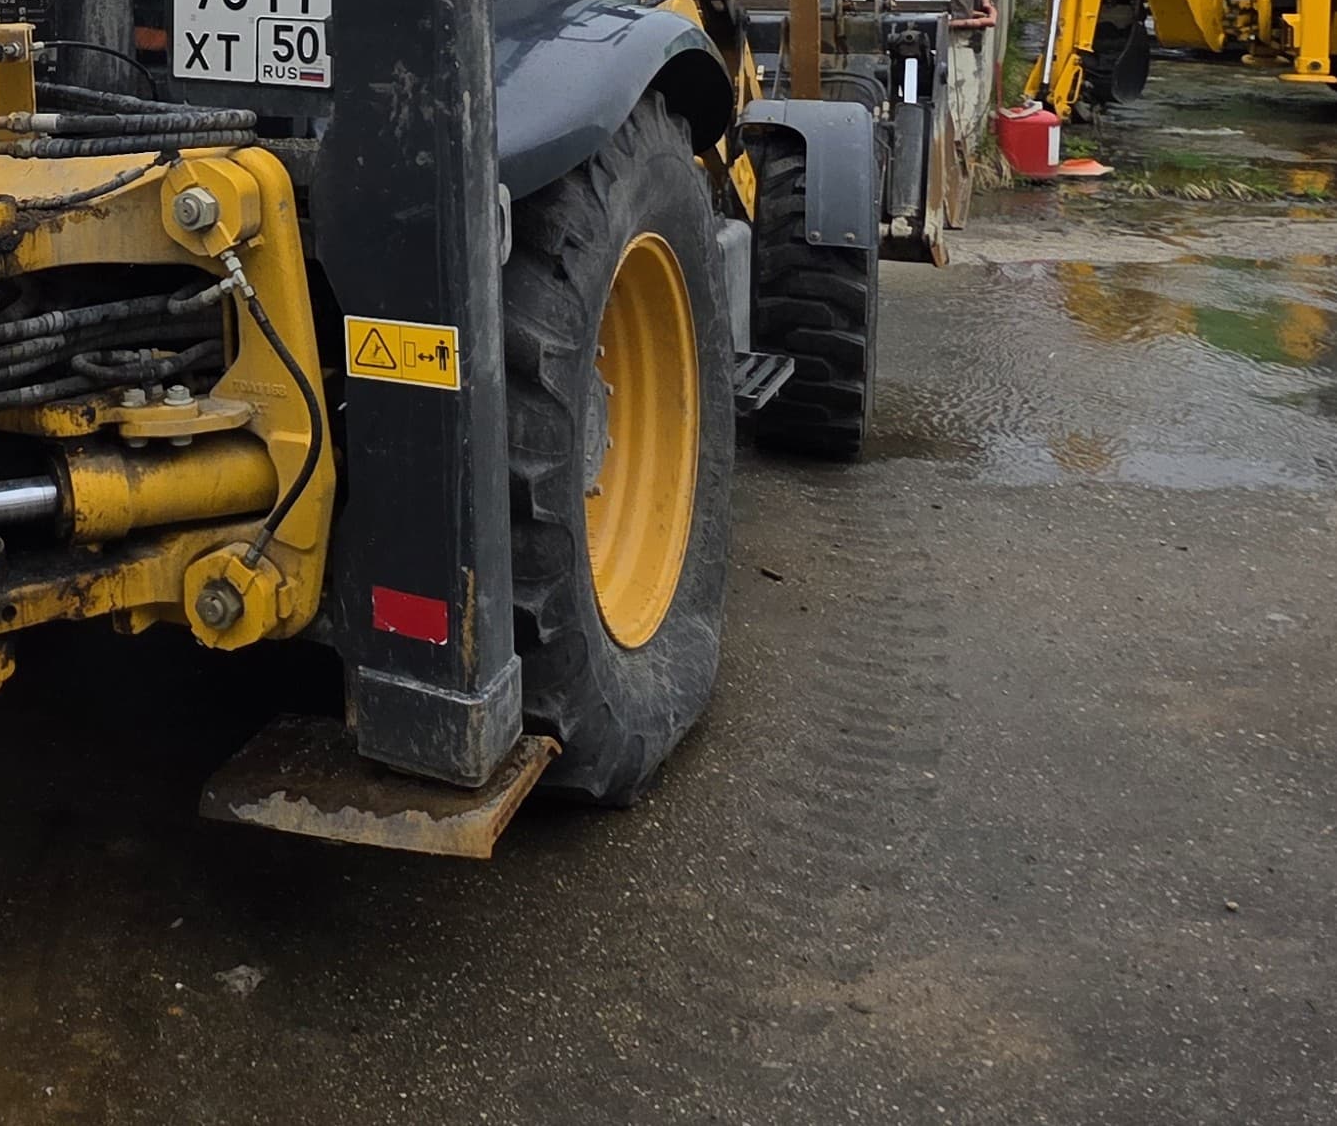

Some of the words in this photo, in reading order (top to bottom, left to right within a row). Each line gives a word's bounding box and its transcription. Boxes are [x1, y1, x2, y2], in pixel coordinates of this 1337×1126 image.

[185, 32, 240, 72] XT
[272, 24, 319, 64] 50
[263, 64, 298, 79] RUS
